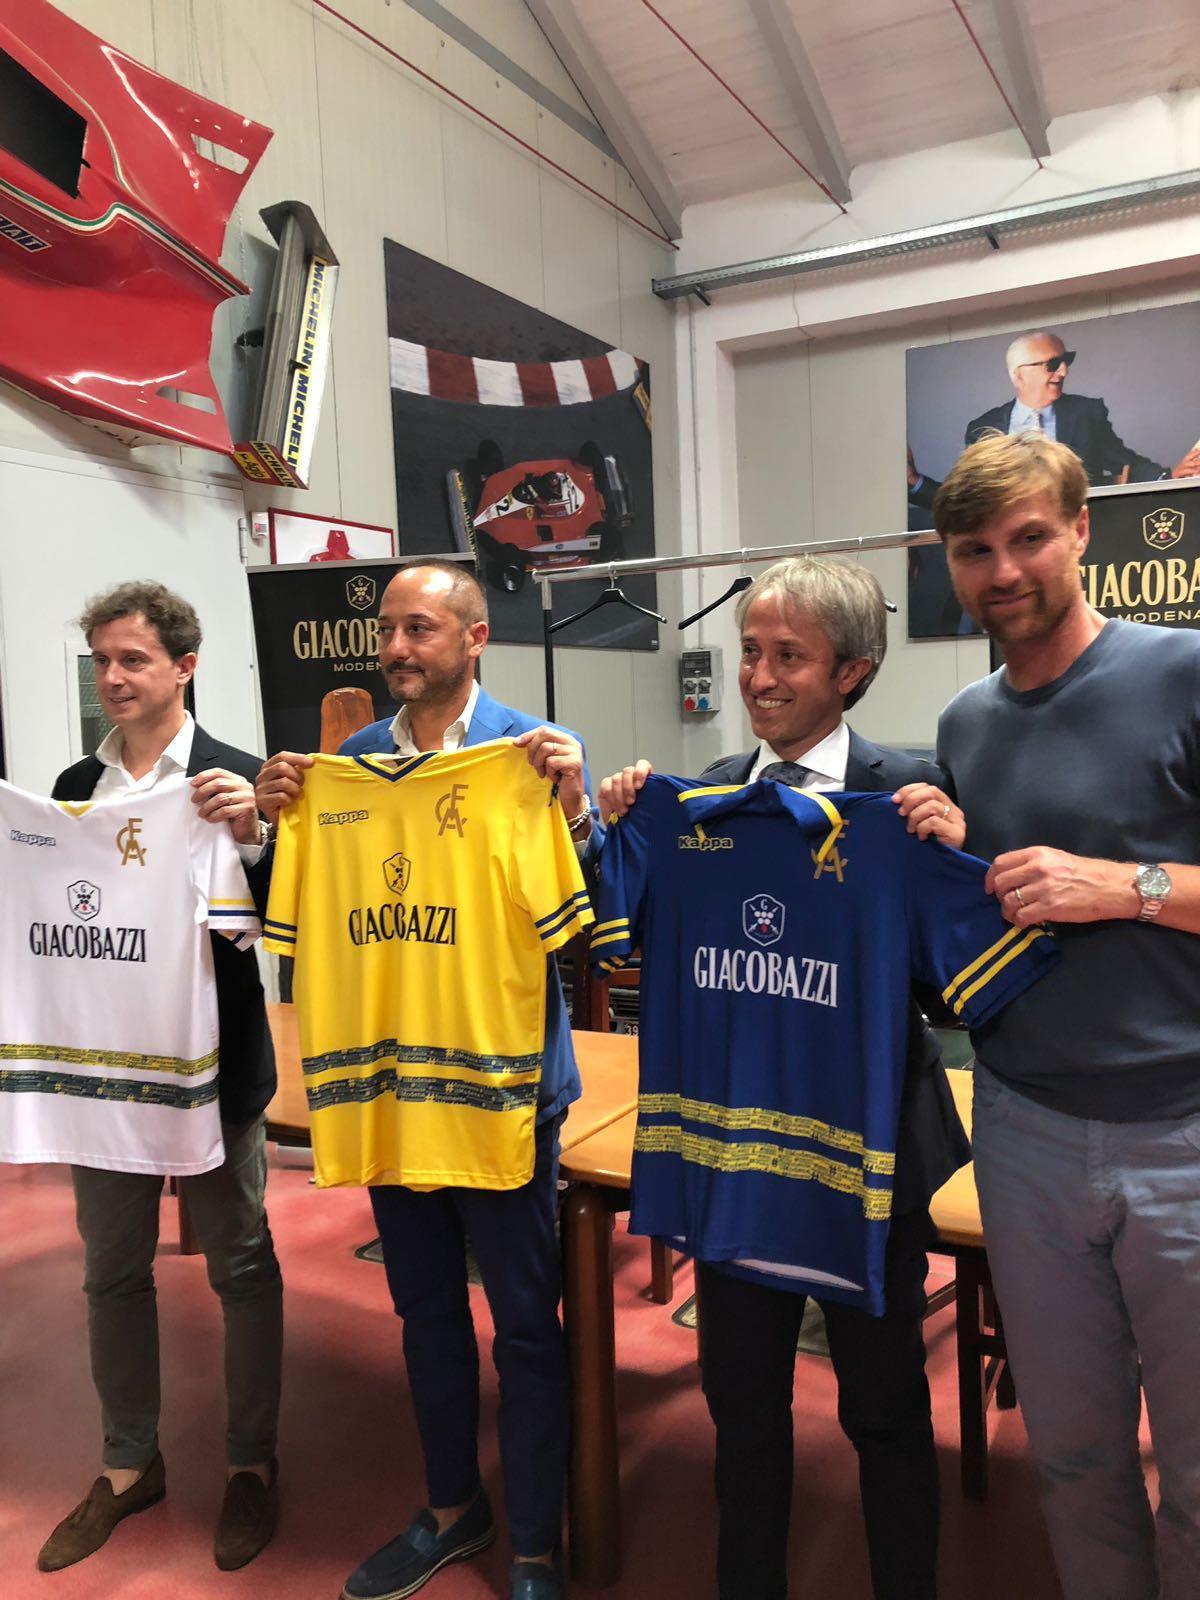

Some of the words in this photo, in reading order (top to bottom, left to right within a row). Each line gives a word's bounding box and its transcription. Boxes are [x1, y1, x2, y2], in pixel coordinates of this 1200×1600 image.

[301, 261, 325, 366] MICHELIN
[287, 373, 310, 466] MICHELI
[252, 442, 298, 488] MICHELIN
[10, 829, 57, 847] Kappa
[319, 808, 370, 827] Kappa
[678, 834, 734, 851] Kappa
[29, 922, 147, 963] GIACOBAZZI
[693, 946, 839, 1008] GIACOBAZZI
